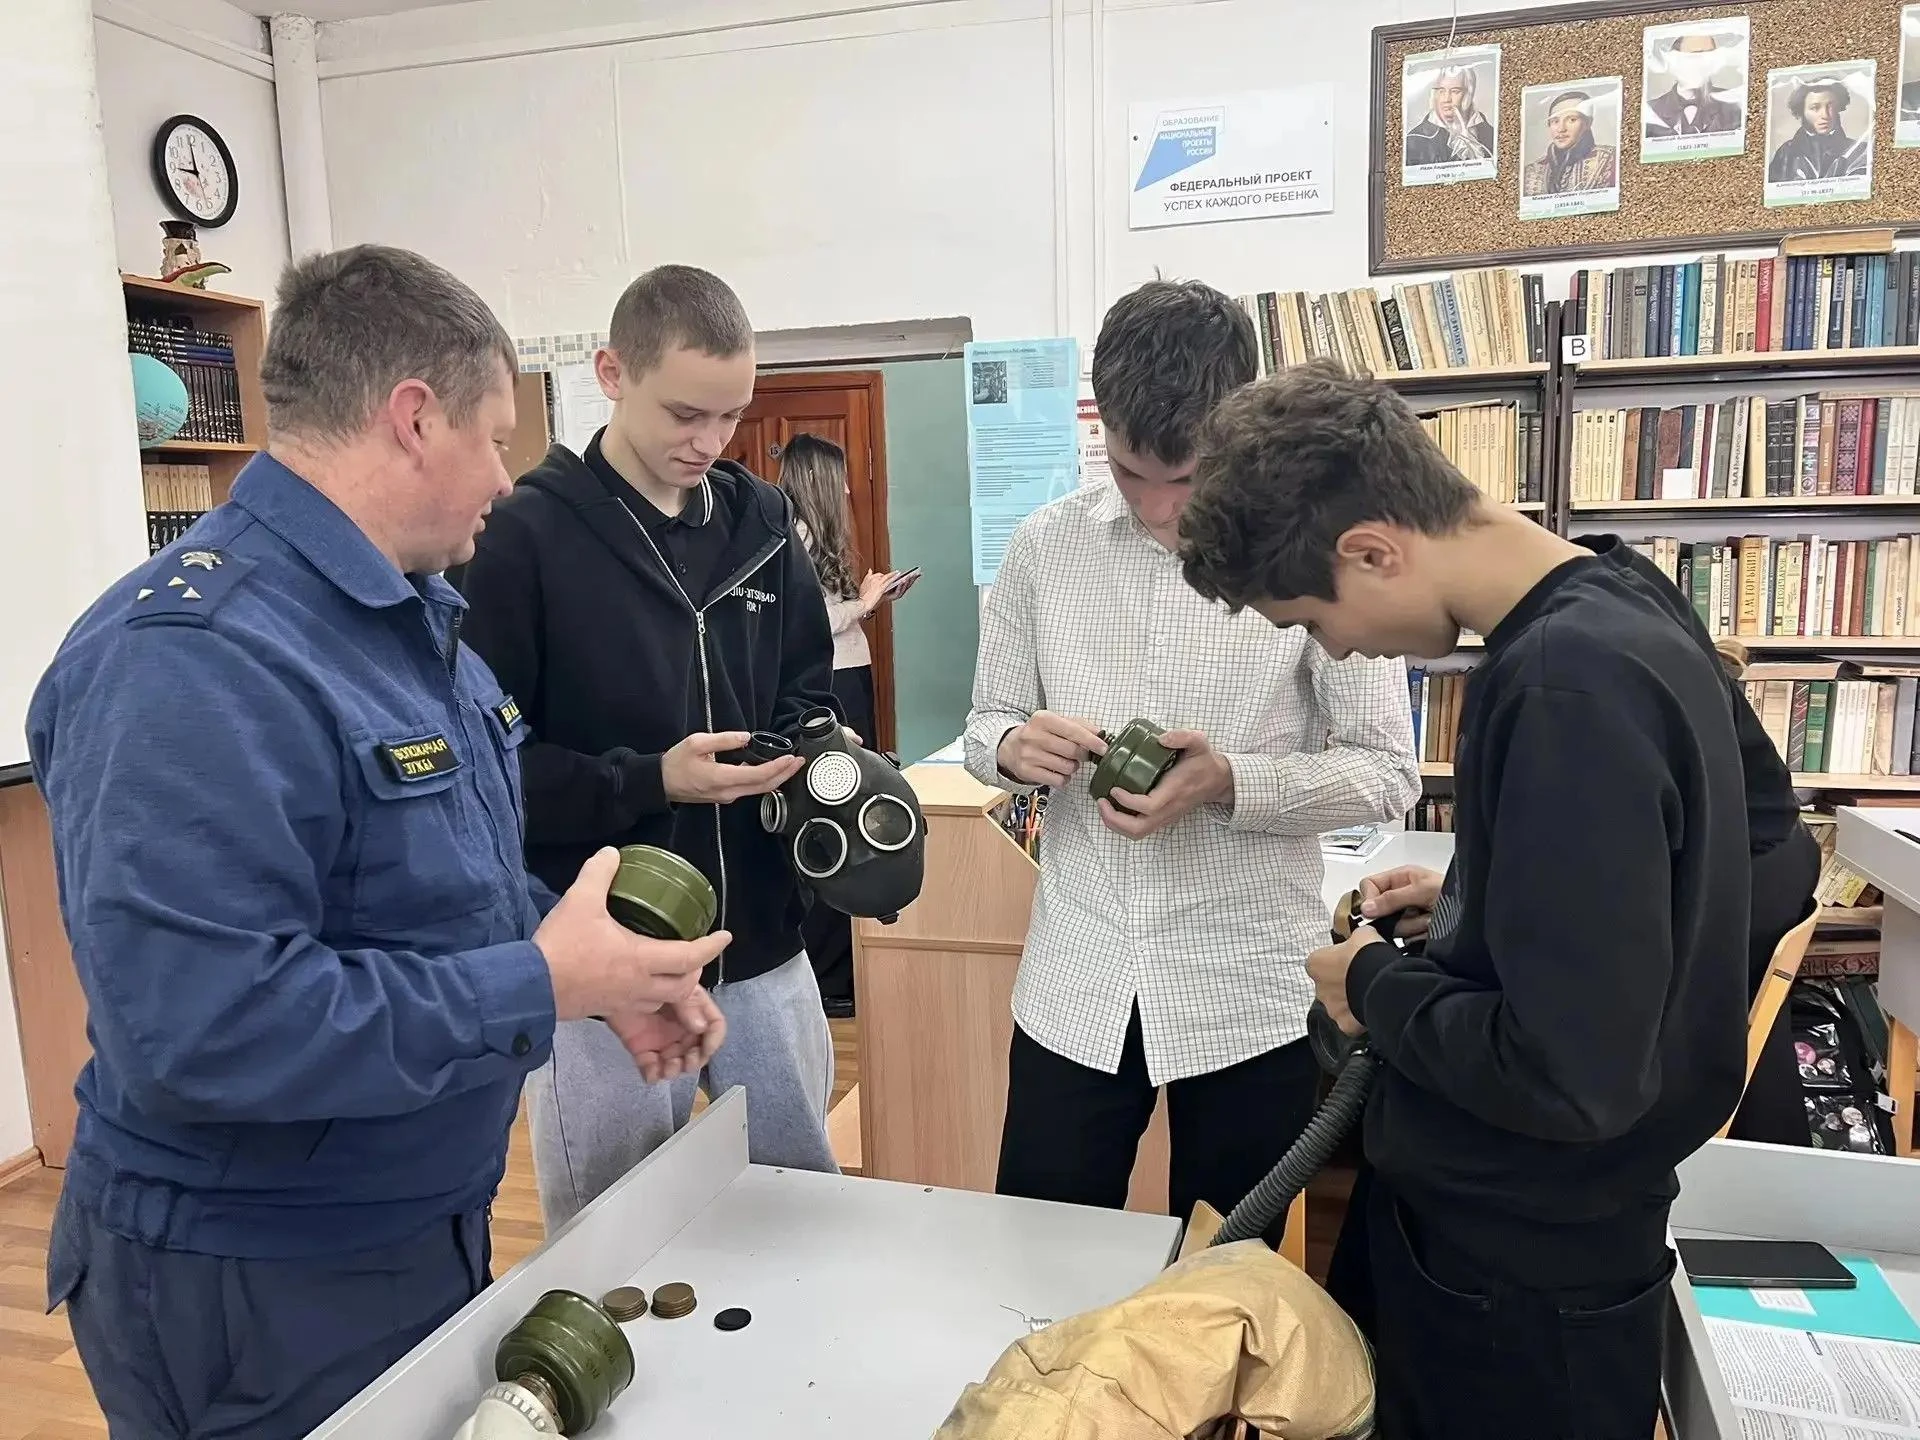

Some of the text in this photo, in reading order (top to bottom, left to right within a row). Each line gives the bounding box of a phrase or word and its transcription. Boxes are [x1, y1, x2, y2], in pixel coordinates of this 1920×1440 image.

[210, 155, 216, 167] 2
[175, 179, 182, 191] 8
[1169, 170, 1313, 193] ФЕДЕРАЛЬНЫЙ ПРОЕКТ
[1164, 189, 1320, 213] УСПЕХ КАЖДОГО РЕБЕНКА
[1571, 338, 1586, 356] В
